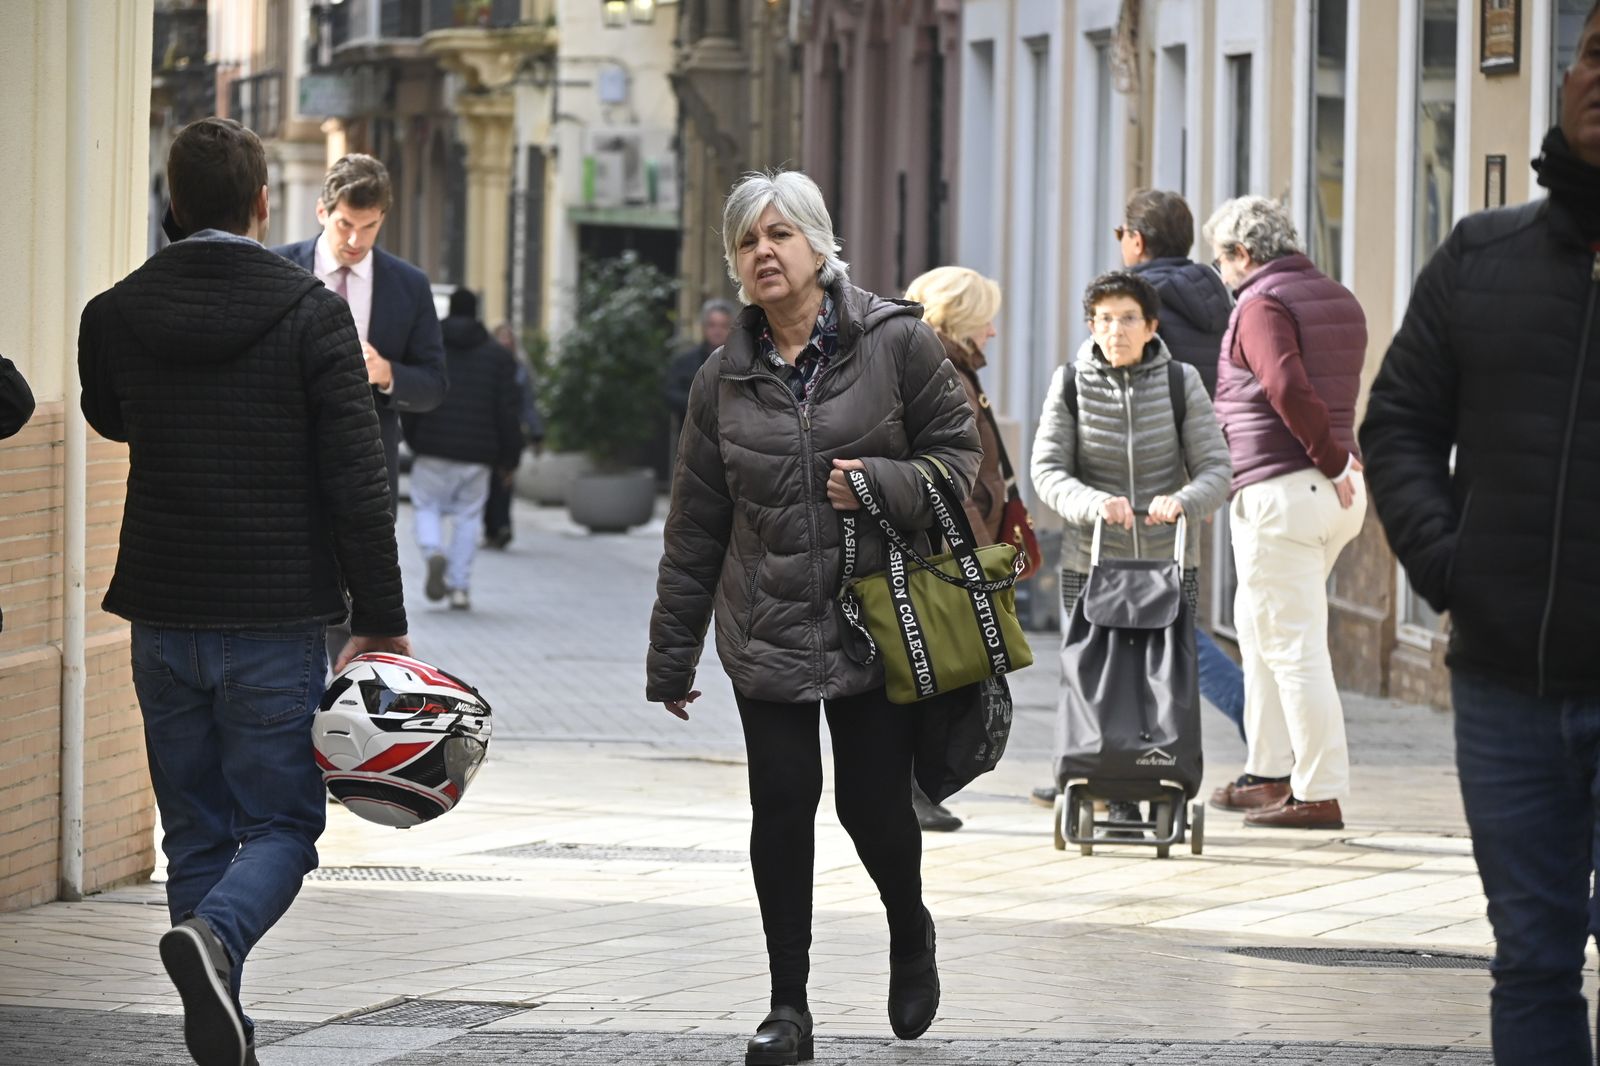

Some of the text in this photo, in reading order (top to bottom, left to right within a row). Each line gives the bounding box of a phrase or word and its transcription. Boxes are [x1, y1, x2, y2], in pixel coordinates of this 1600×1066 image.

[849, 470, 880, 515] SHION
[888, 542, 934, 696] ASHION COLLECTION
[960, 555, 1000, 648] COLLECION
